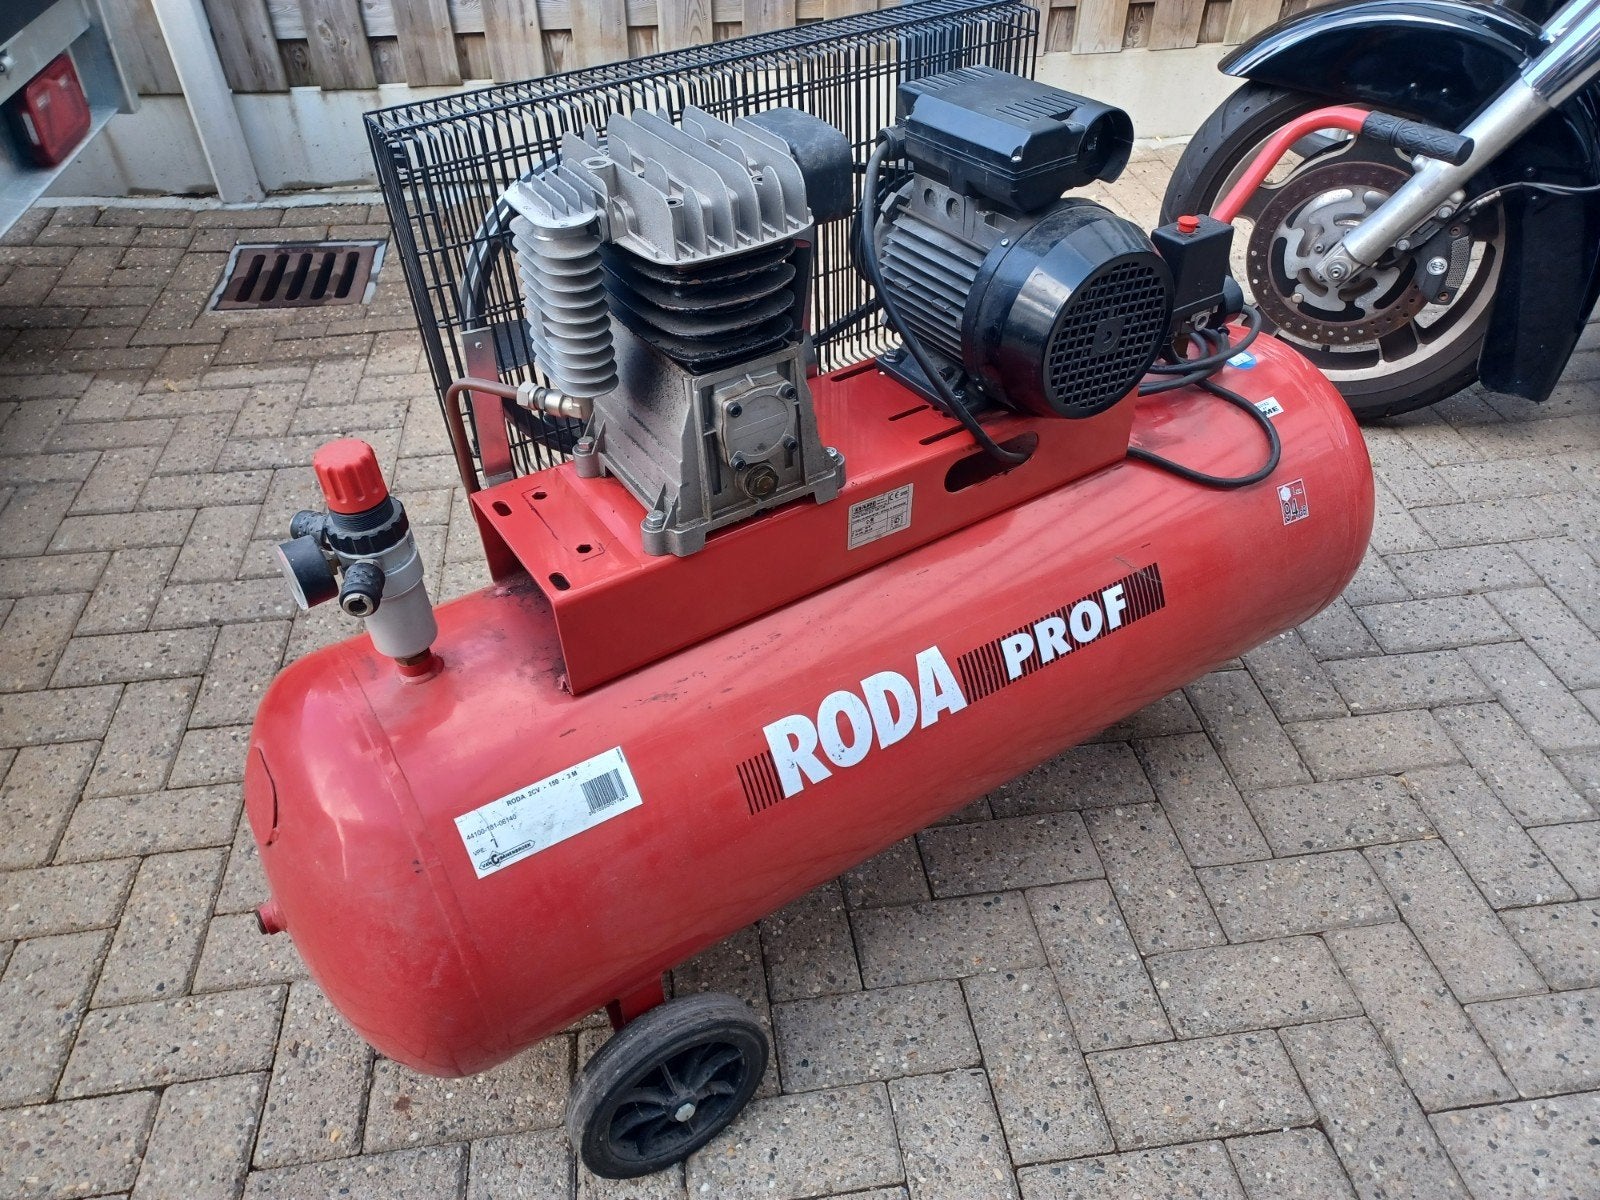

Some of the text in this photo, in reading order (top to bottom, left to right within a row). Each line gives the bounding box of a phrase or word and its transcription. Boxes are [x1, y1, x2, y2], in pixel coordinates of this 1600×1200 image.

[762, 583, 1127, 799] RODA PROF
[506, 794, 526, 807] RODA
[528, 786, 541, 797] 2CV
[548, 778, 560, 788] 150
[571, 770, 578, 778] M
